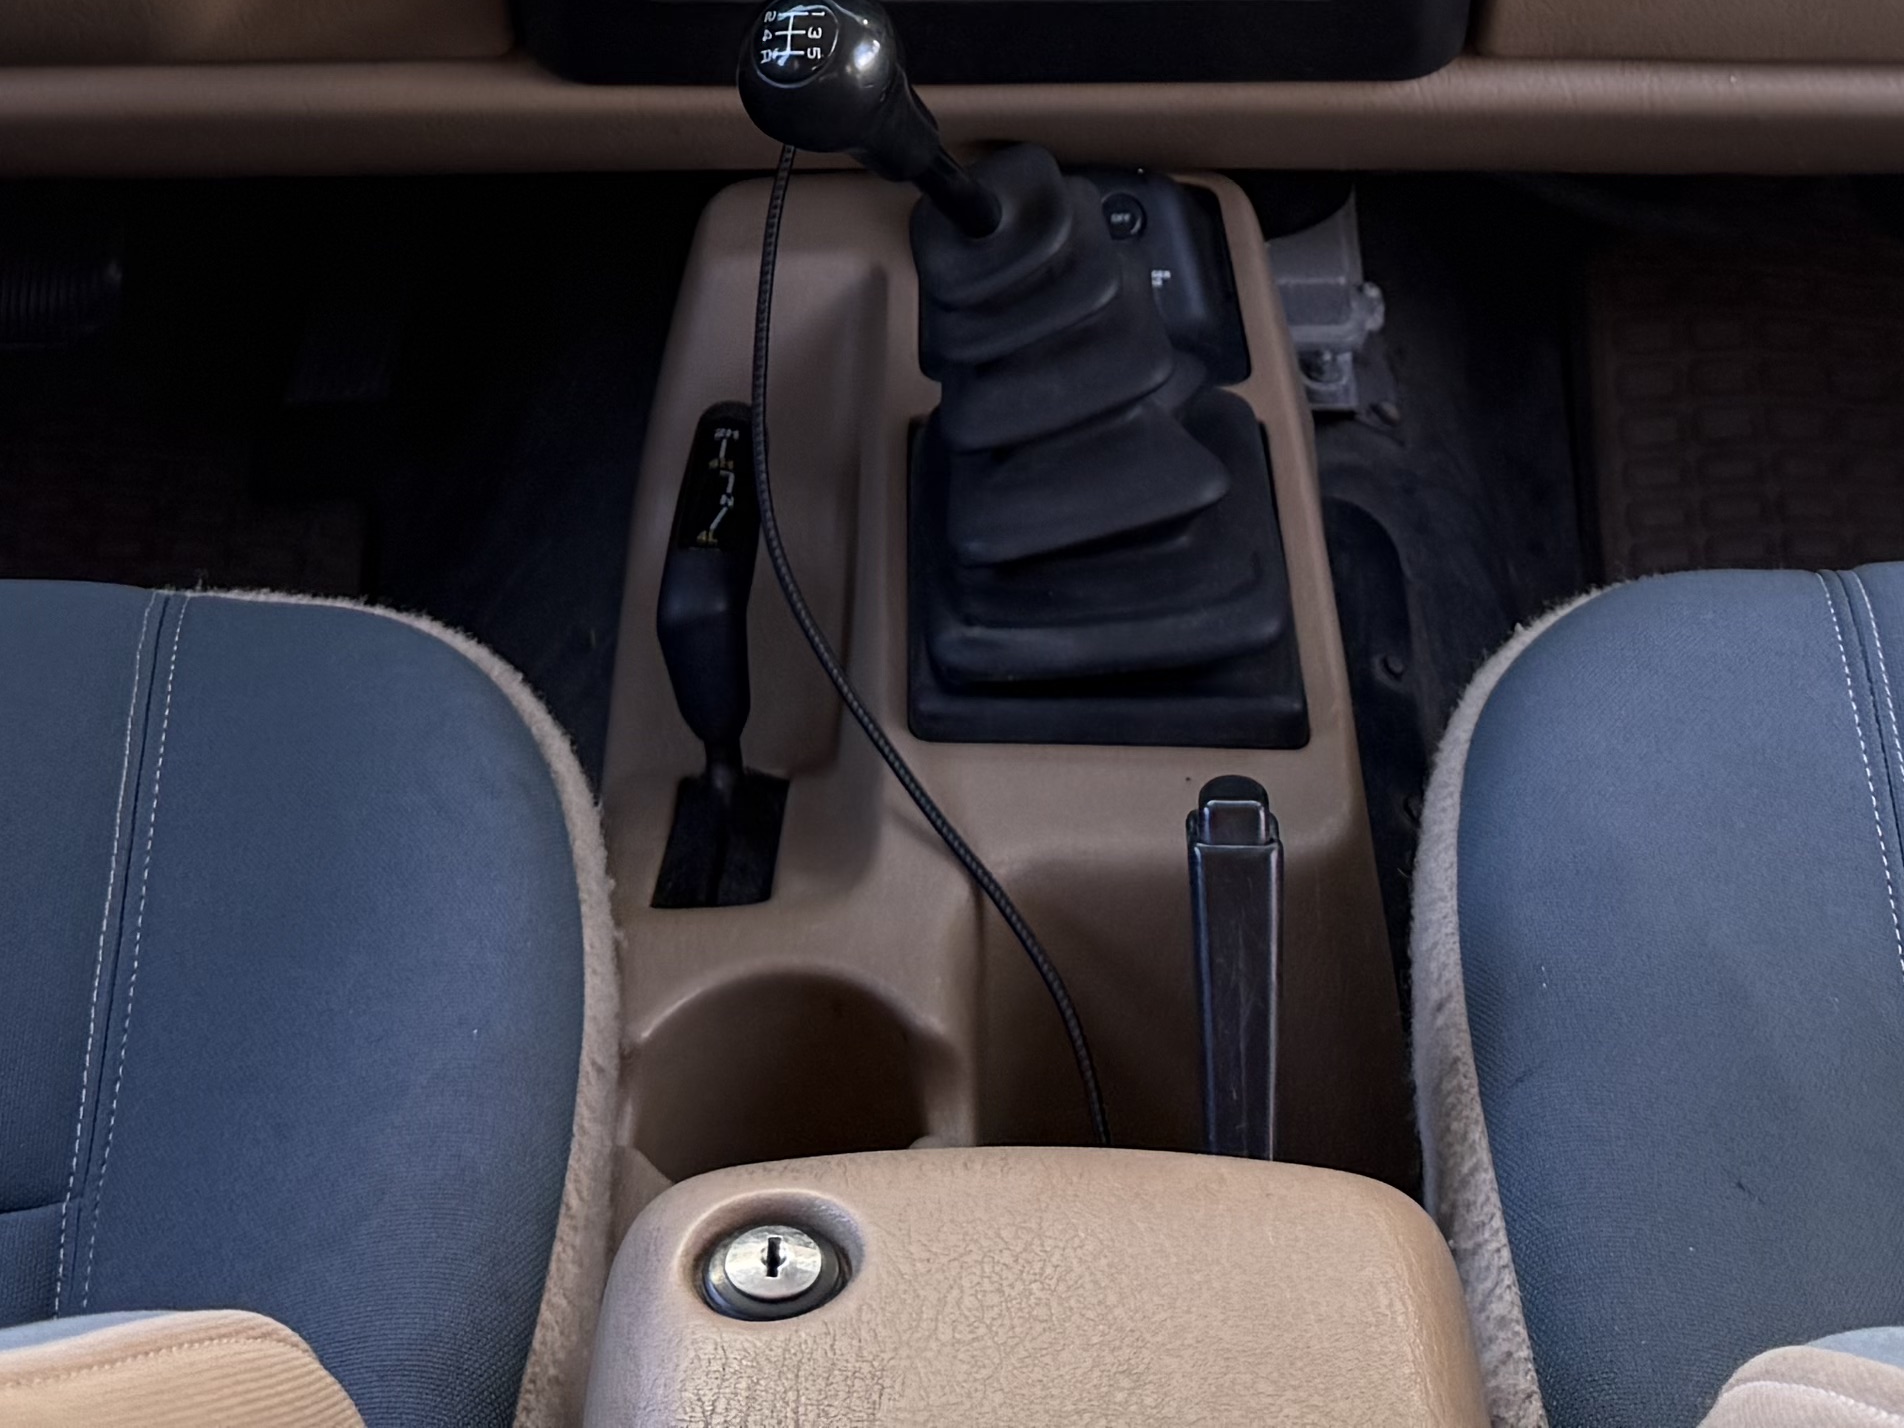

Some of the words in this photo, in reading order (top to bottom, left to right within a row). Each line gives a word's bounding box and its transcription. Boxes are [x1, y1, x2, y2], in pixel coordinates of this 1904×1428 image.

[764, 11, 776, 22] 2
[808, 27, 822, 39] 3
[807, 47, 821, 59] 5
[1110, 213, 1131, 224] OFF
[696, 529, 718, 546] 4L
